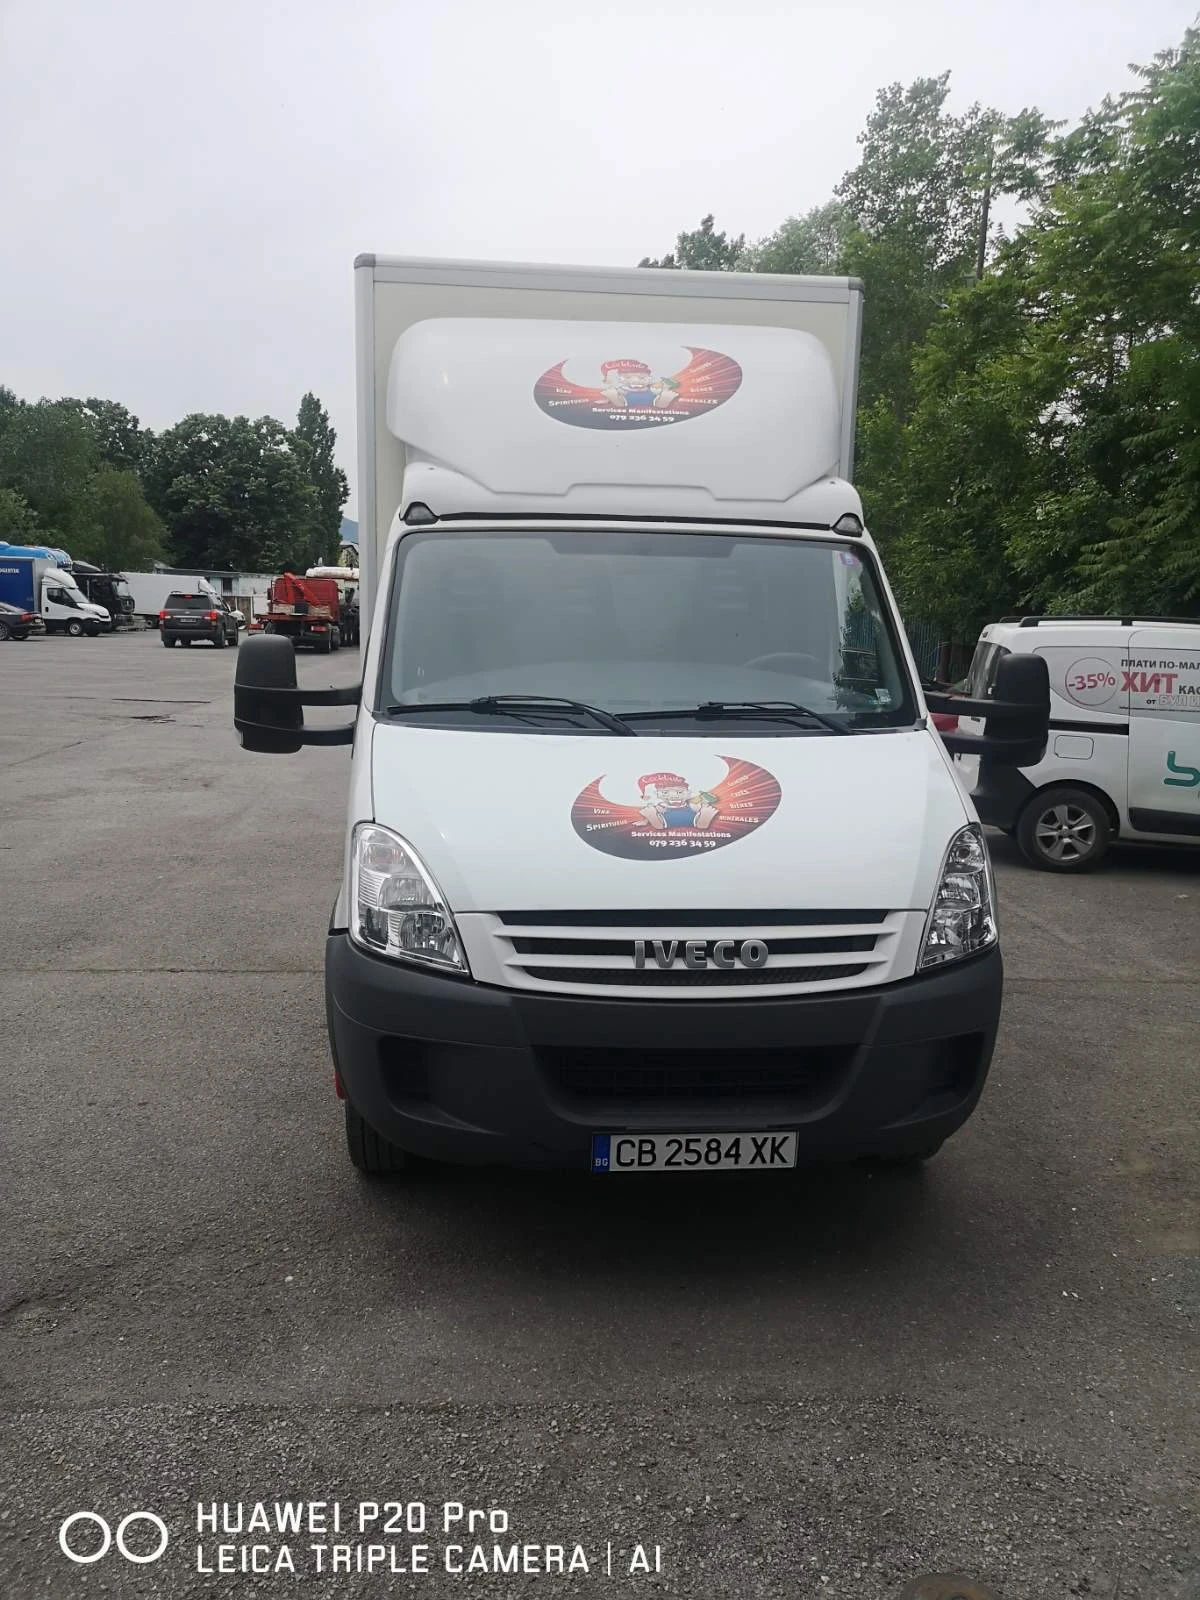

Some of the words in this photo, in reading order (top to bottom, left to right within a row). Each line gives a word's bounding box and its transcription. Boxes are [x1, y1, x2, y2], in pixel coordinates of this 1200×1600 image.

[1120, 659, 1156, 669] ПЛАТИ
[1068, 672, 1116, 691] -35%
[1120, 671, 1179, 694] ХИТ
[649, 839, 667, 848] 079
[668, 838, 687, 848] 236
[689, 840, 703, 848] 34
[704, 840, 717, 848] 59
[634, 939, 769, 969] IVECO
[595, 1158, 609, 1167] BG
[664, 1137, 741, 1167] 2584
